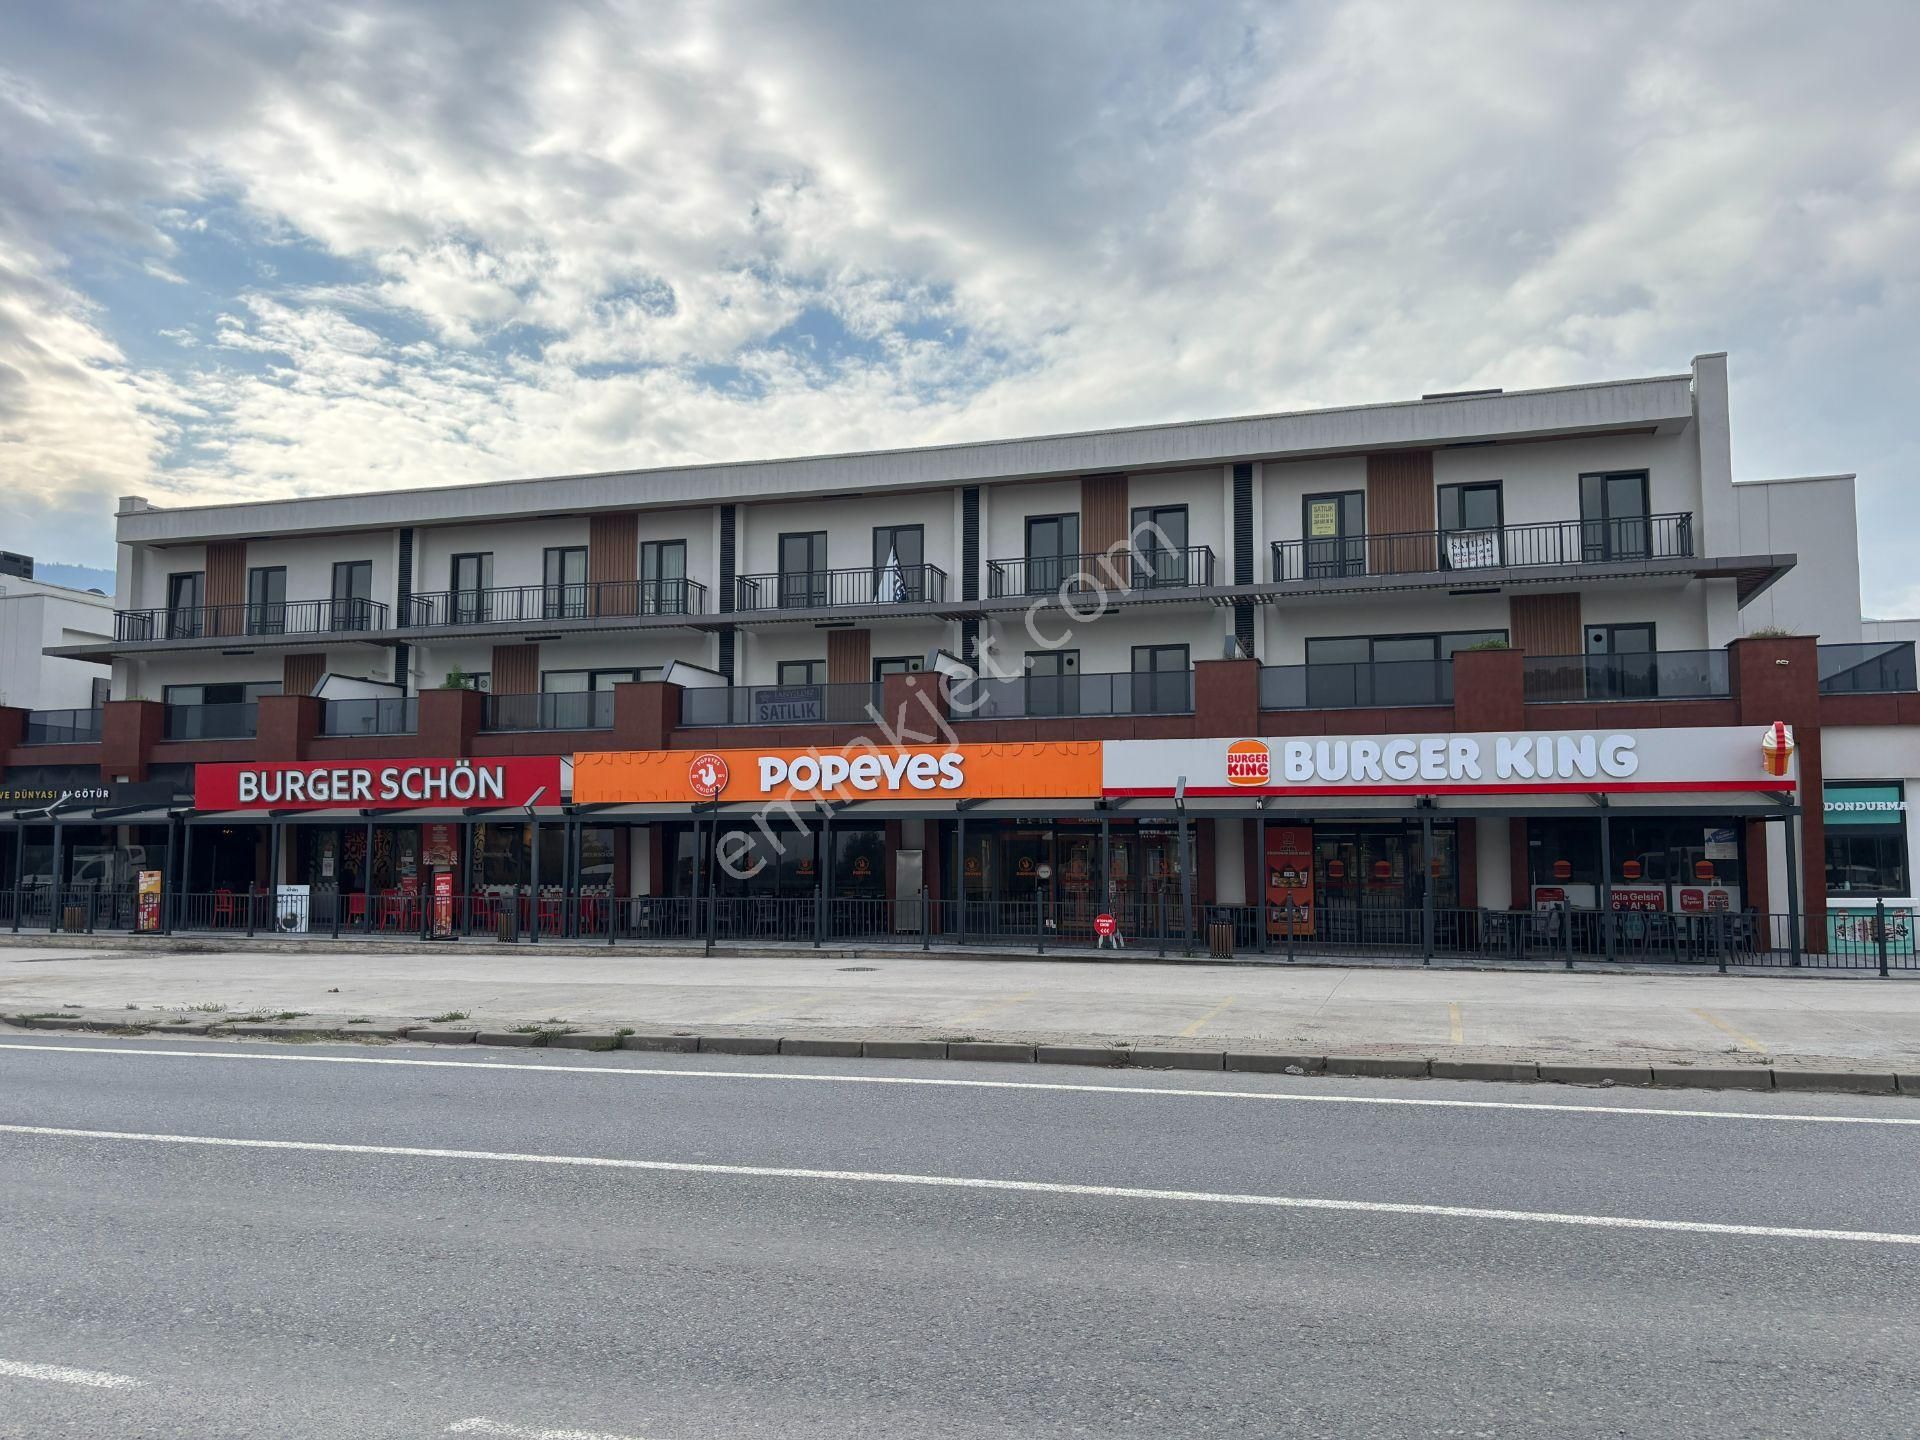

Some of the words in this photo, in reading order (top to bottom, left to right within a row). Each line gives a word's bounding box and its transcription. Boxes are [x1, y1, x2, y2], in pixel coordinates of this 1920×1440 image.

[1451, 537, 1493, 550] SATIK
[761, 702, 816, 720] SATILIK
[1227, 753, 1269, 763] BURGER
[1284, 738, 1482, 781] BURGER
[1495, 735, 1639, 779] KING
[1227, 763, 1269, 776] KING
[239, 768, 374, 802] BURGER
[380, 759, 504, 800] SCHÖN
[14, 789, 57, 799] DÜNYASI
[1823, 801, 1911, 811] DONDURMA
[1611, 892, 1628, 901] ıkla
